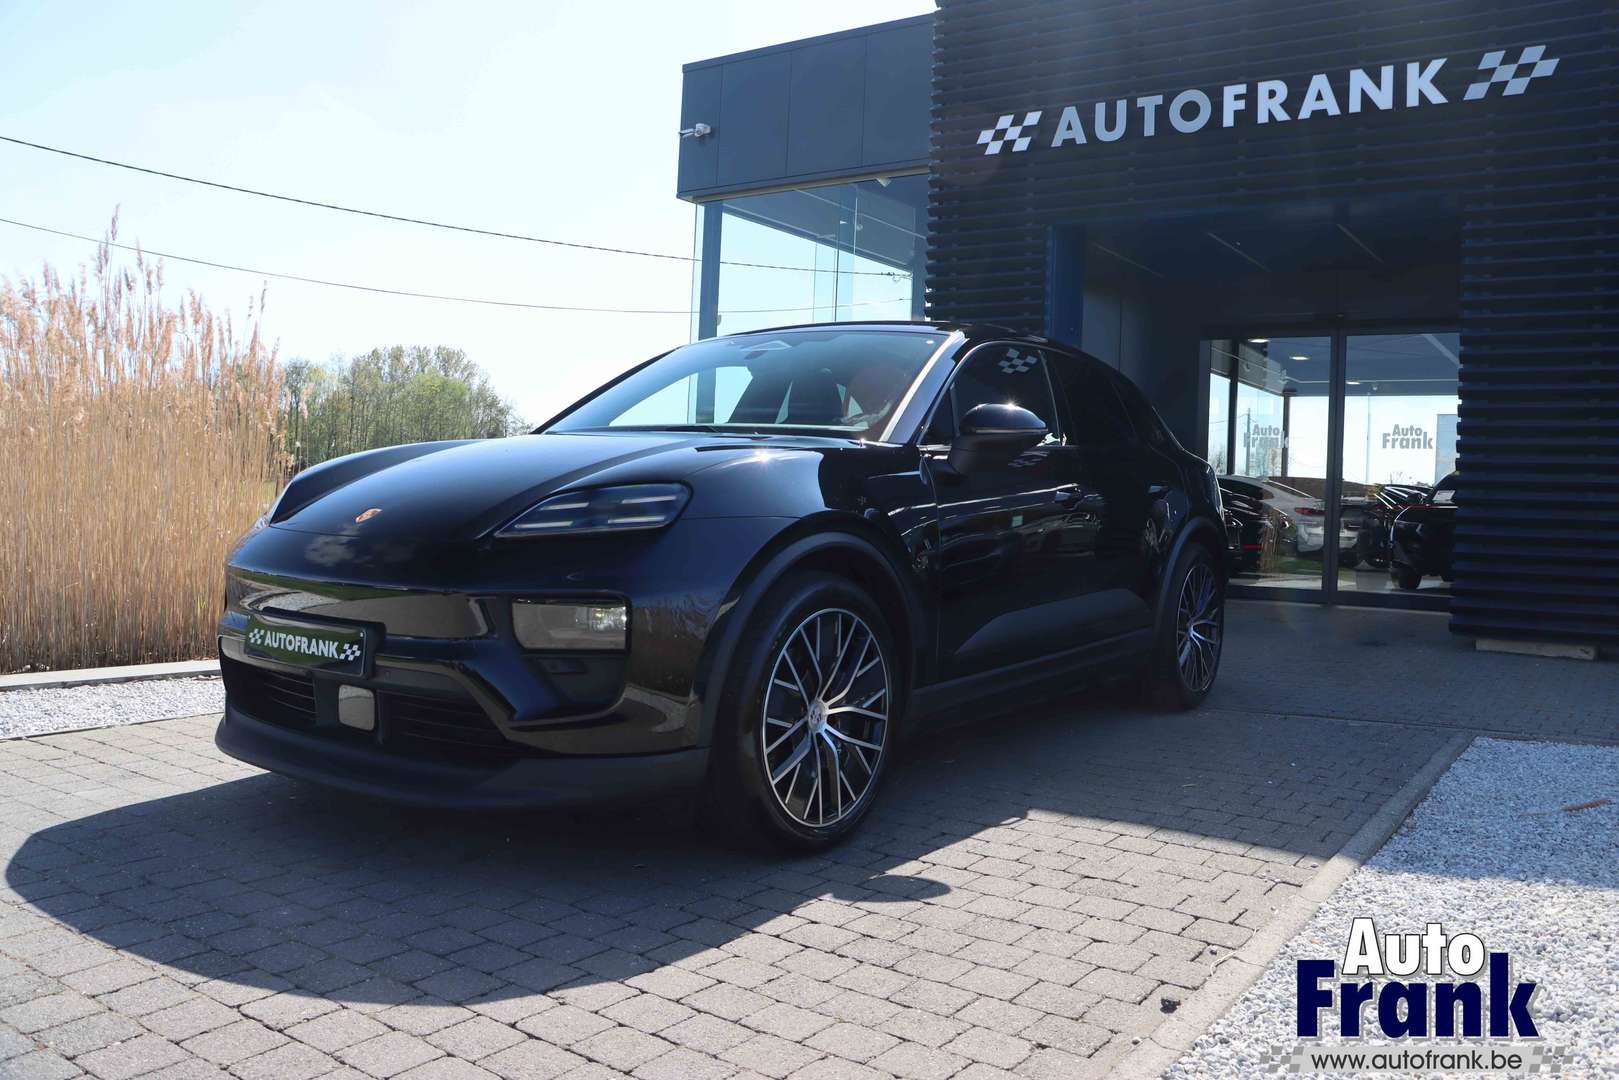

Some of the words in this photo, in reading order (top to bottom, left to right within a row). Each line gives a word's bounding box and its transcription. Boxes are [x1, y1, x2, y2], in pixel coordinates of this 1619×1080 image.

[1051, 57, 1449, 147] AUTOFRANK
[1252, 424, 1280, 436] Auto
[1392, 424, 1423, 436] Auto
[1382, 432, 1433, 449] Frank
[264, 631, 339, 659] AUTOFRANK
